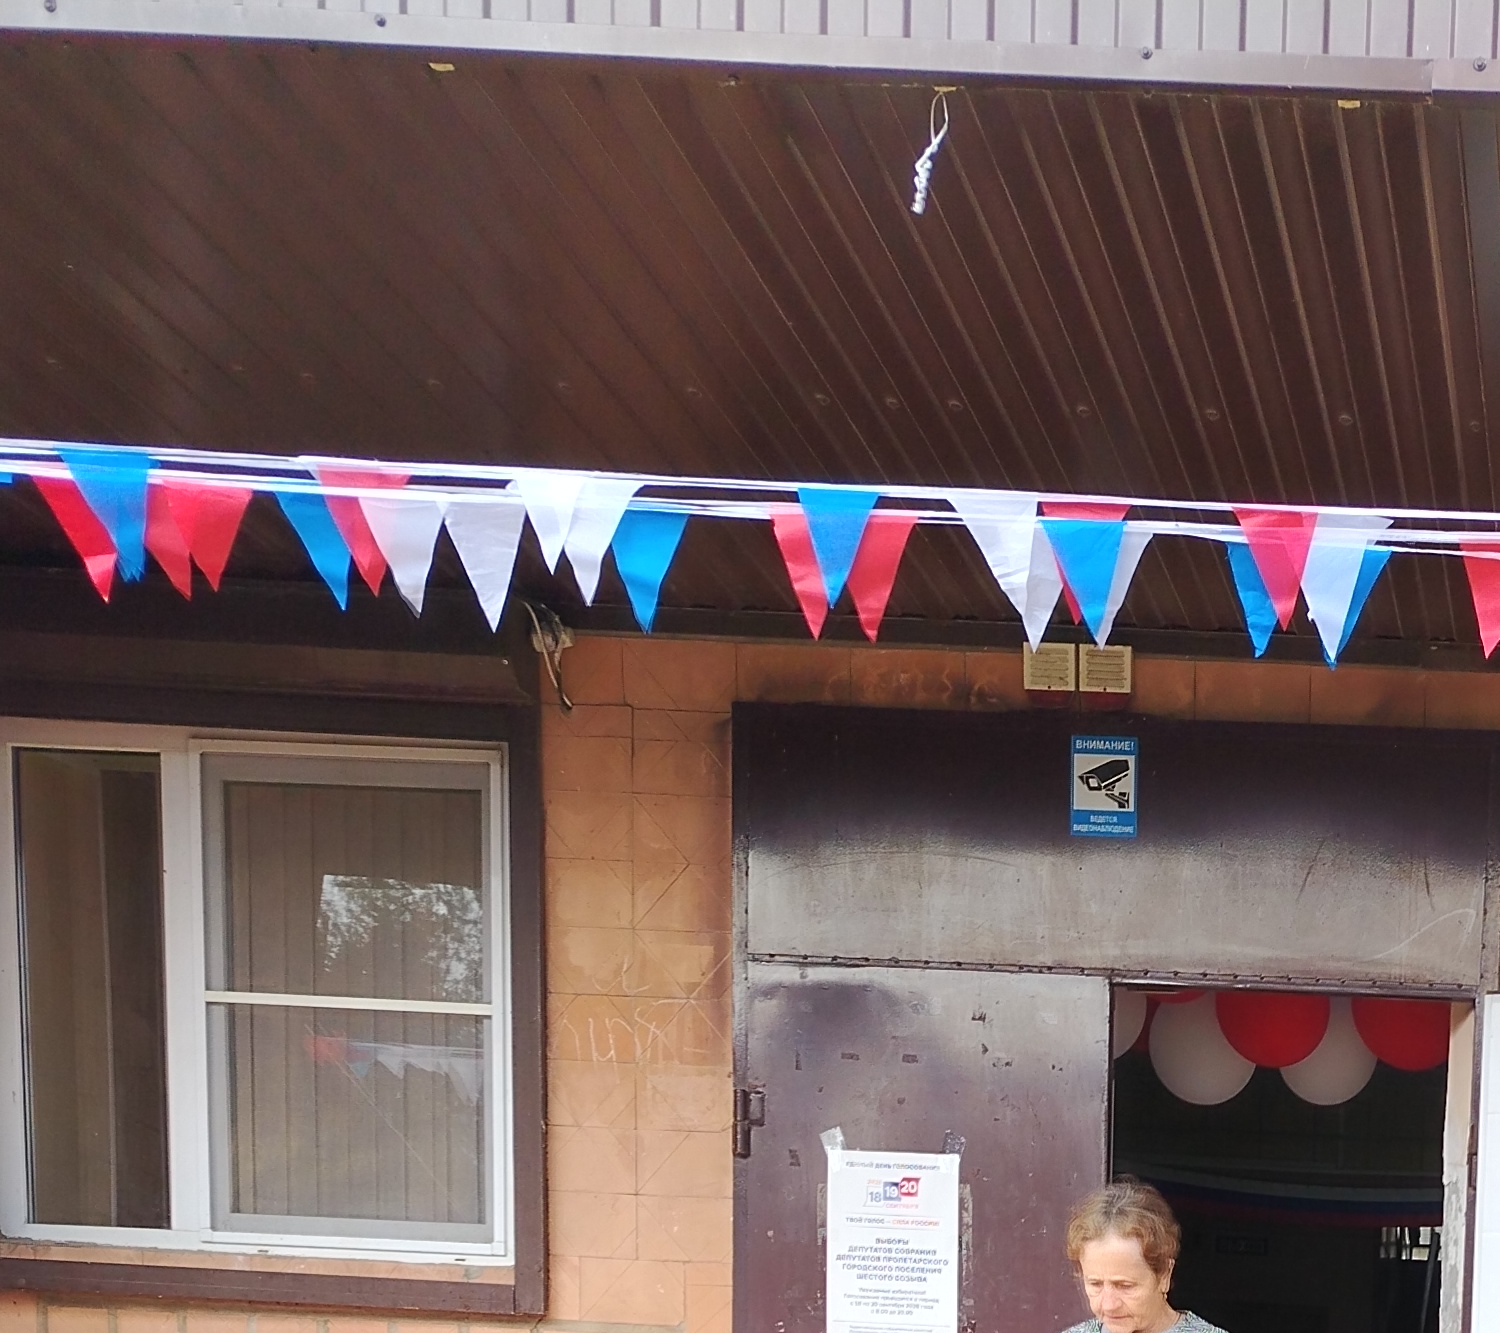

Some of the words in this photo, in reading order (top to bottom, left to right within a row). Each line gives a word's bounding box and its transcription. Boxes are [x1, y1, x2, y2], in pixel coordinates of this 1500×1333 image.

[1076, 740, 1134, 750] ВНИМАНИЕ!
[884, 1186, 899, 1198] 19
[900, 1181, 917, 1194] 20
[868, 1191, 882, 1203] 18
[875, 1237, 909, 1246] ВЫБОРЫ
[848, 1245, 892, 1254] ДЕПУТАТОВ
[894, 1247, 937, 1256] СОБРАНИЯ
[836, 1253, 881, 1263] ДЕПУТАТОВ
[842, 1263, 893, 1273] ГОРОДСКОГО
[894, 1265, 942, 1275] ПОСЕЛЕНИЯ
[856, 1273, 893, 1282] ШЕСТОГО
[895, 1275, 927, 1283] СОЗЫВА
